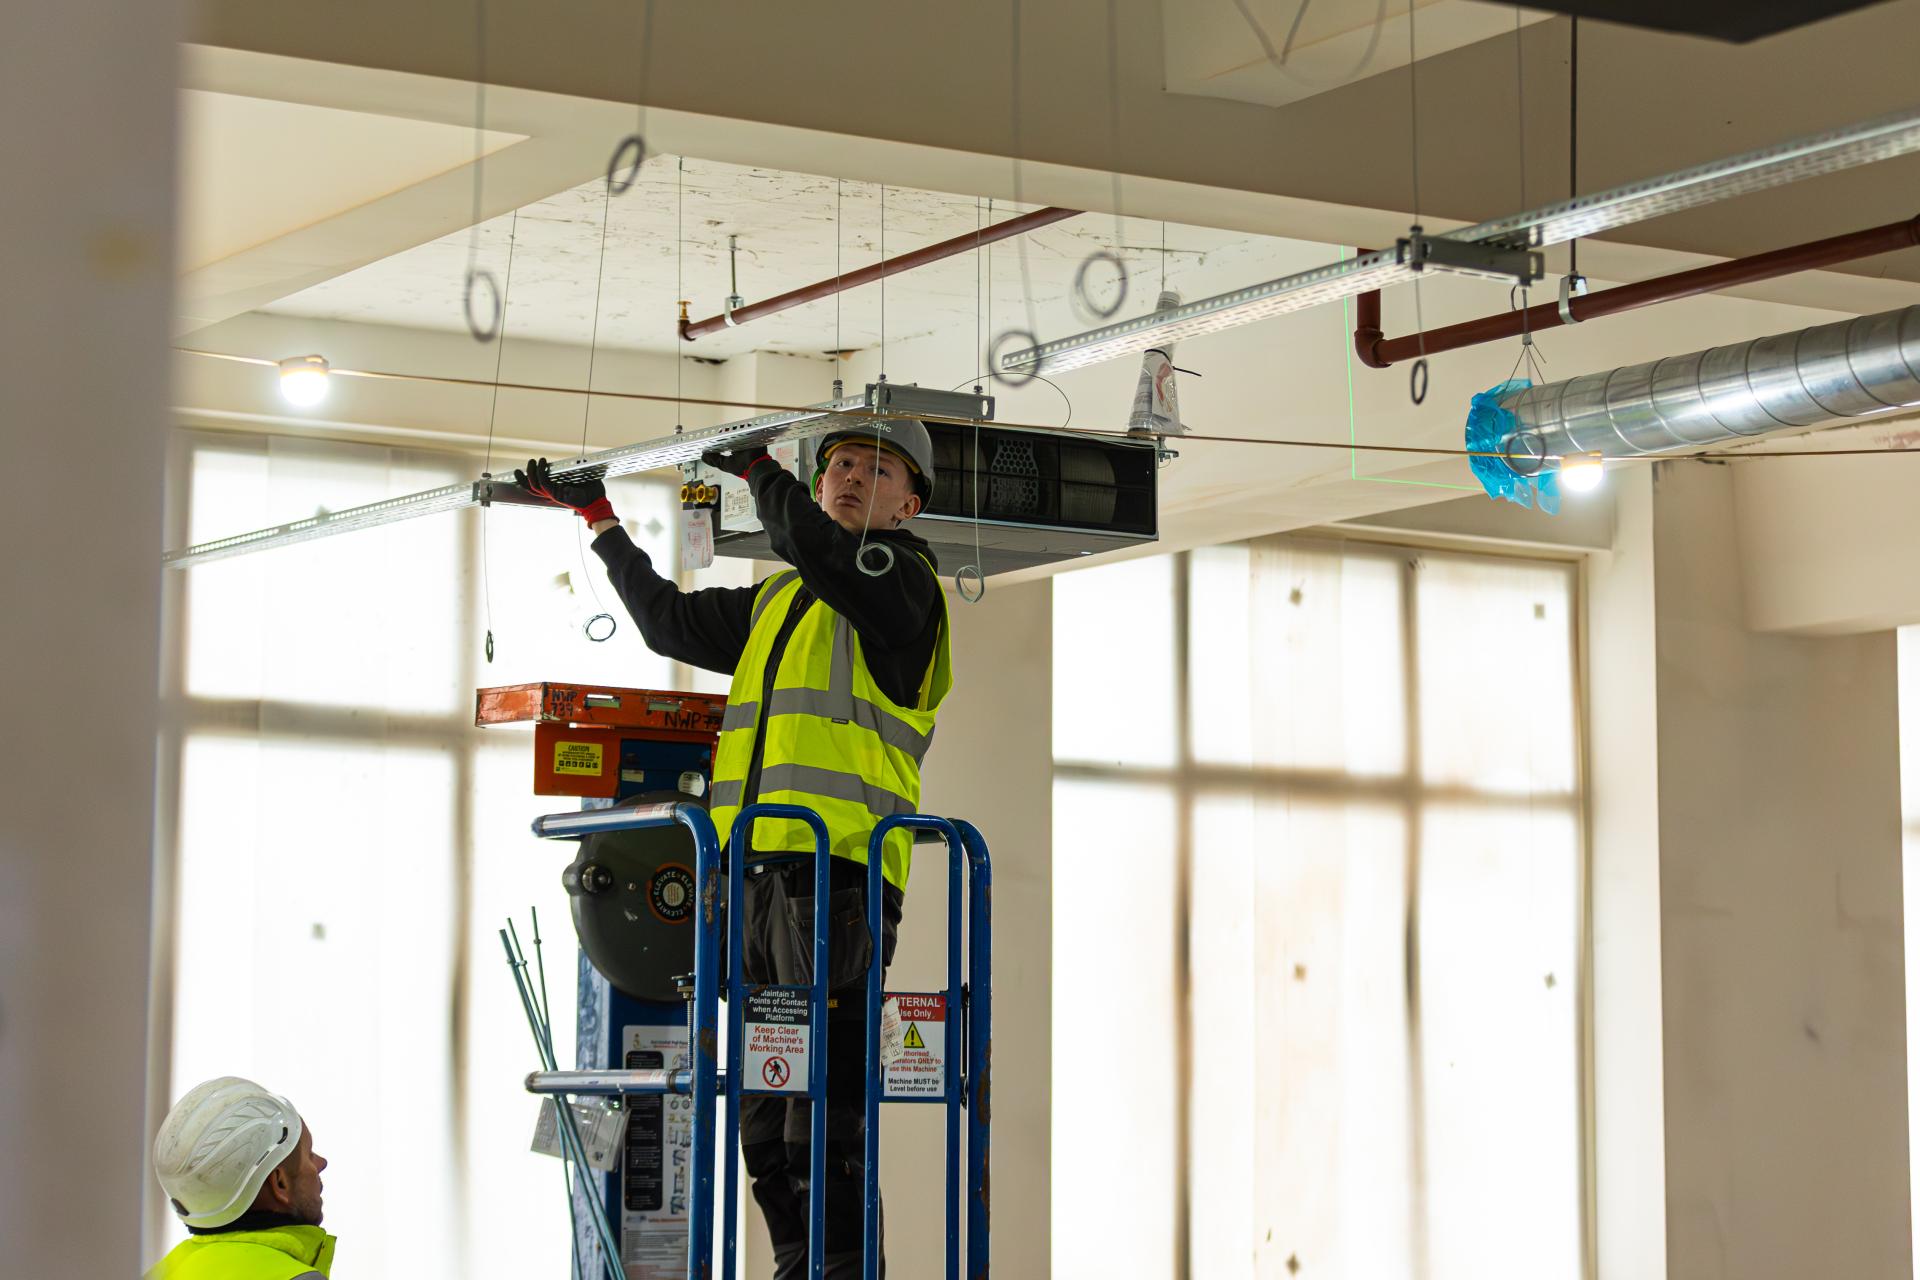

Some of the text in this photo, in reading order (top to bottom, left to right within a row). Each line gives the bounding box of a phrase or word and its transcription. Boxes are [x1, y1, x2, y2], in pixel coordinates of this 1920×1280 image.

[552, 689, 577, 702] NWP
[749, 996, 807, 1006] Points of Contact
[752, 1005, 808, 1016] when Accessing
[913, 1009, 932, 1020] Only
[765, 1013, 795, 1022] Platform
[754, 1025, 799, 1036] Keep Clear
[752, 1034, 804, 1045] of Machine's
[749, 1043, 804, 1055] Working Area
[888, 1077, 913, 1085] Machine
